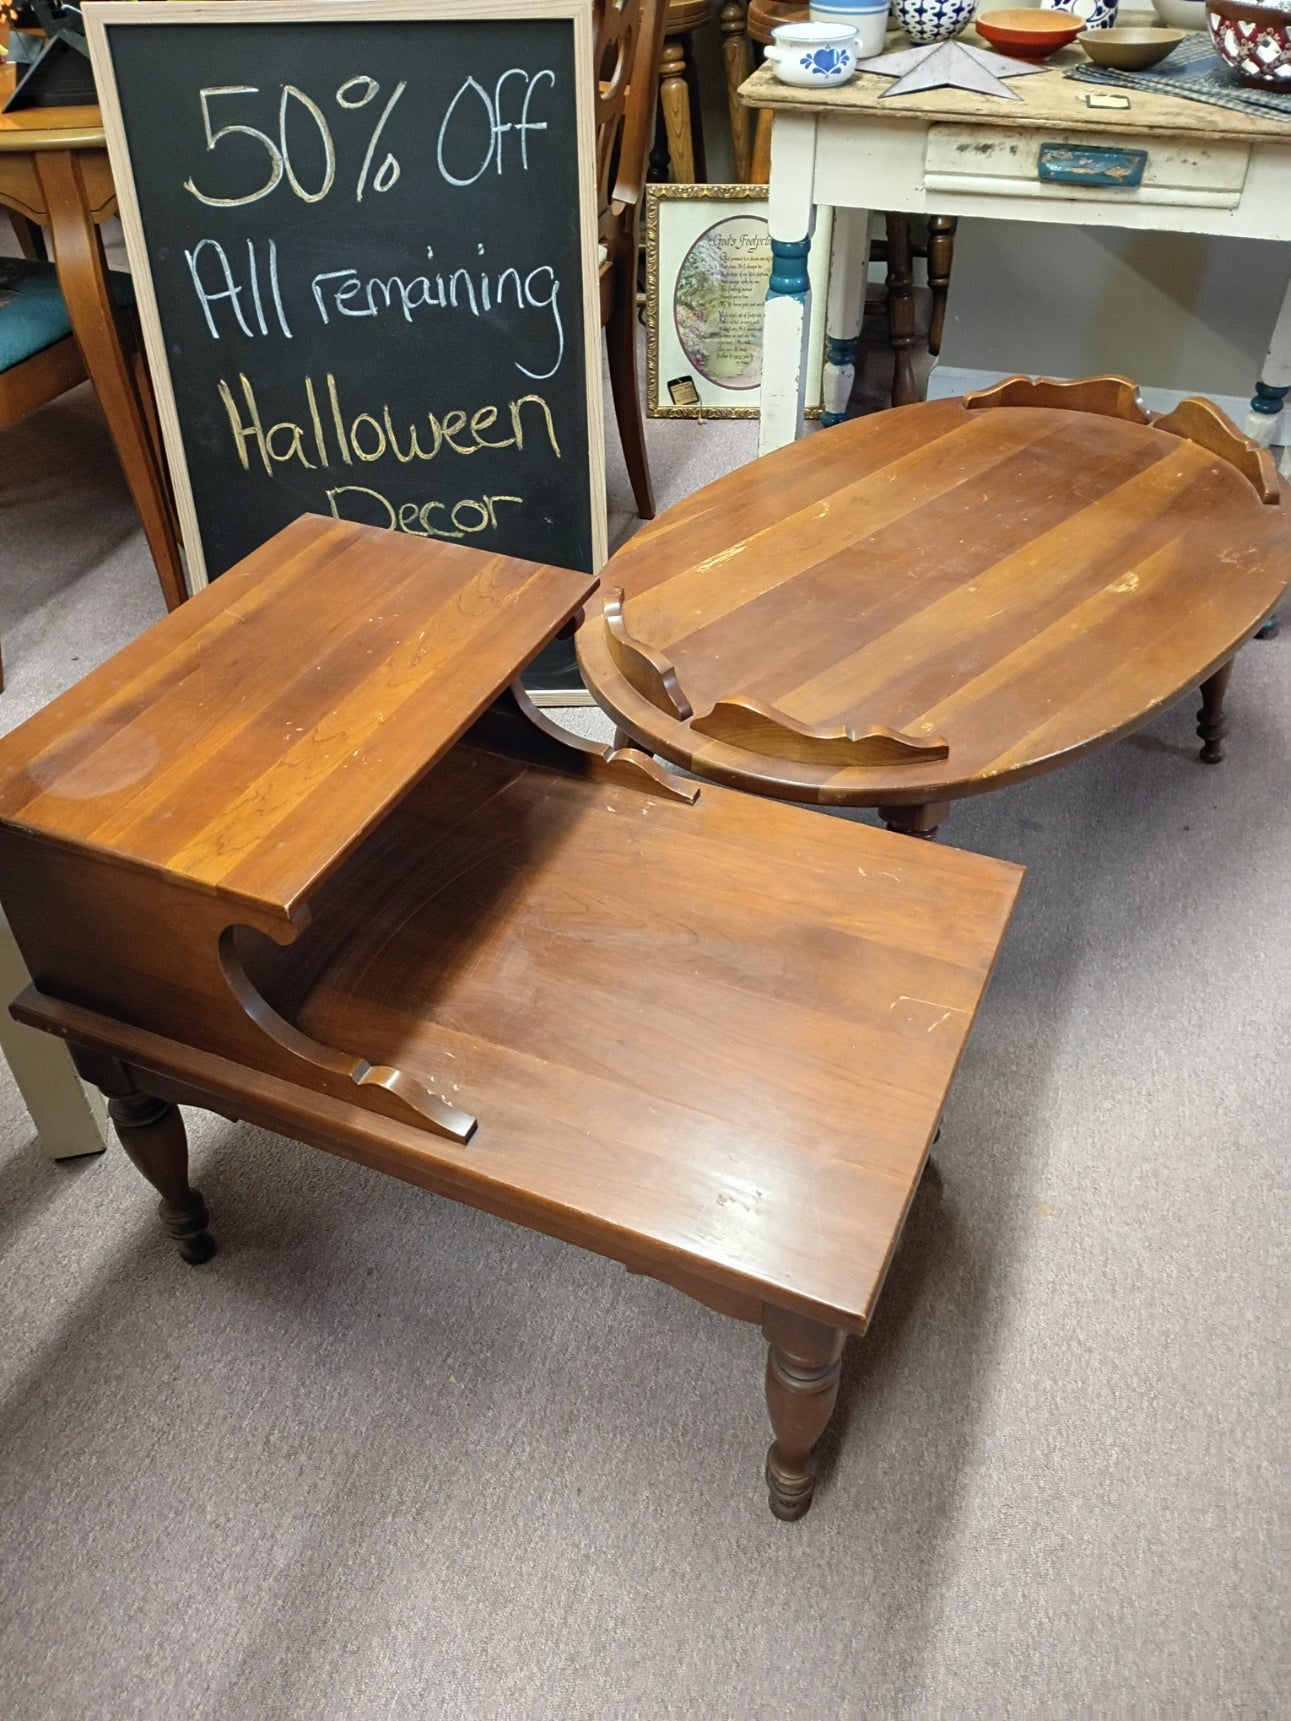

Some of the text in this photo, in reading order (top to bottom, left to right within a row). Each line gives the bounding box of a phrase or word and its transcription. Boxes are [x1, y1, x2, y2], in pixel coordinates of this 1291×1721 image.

[183, 68, 556, 207] 50% Off
[735, 233, 771, 254] Footpri
[183, 237, 565, 380] All remaining
[217, 372, 562, 478] Halloween
[325, 485, 524, 538] Decor
